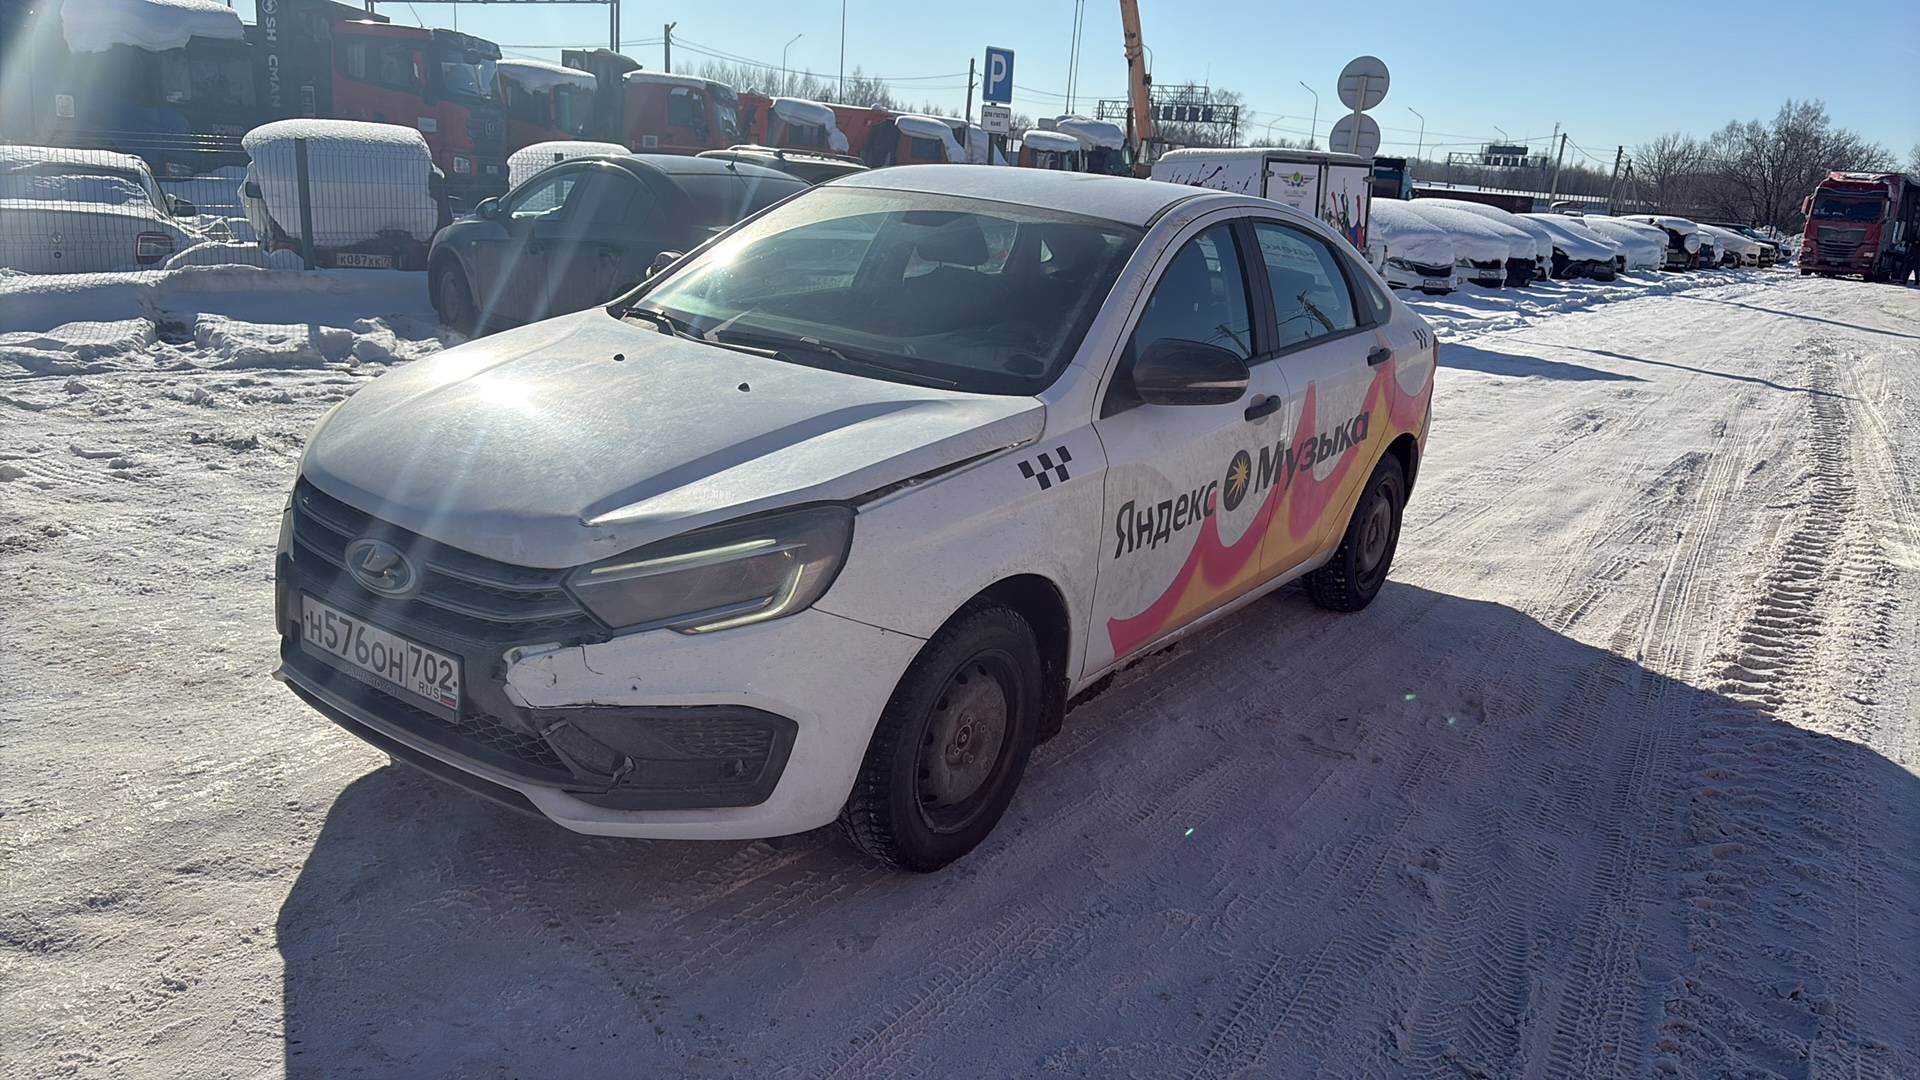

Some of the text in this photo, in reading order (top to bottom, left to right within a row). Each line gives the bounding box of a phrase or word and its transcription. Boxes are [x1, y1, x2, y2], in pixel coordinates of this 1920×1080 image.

[989, 53, 1007, 95] P
[1113, 411, 1369, 560] Яндекс Музыка
[409, 645, 453, 692] 702
[418, 680, 440, 700] RUS
